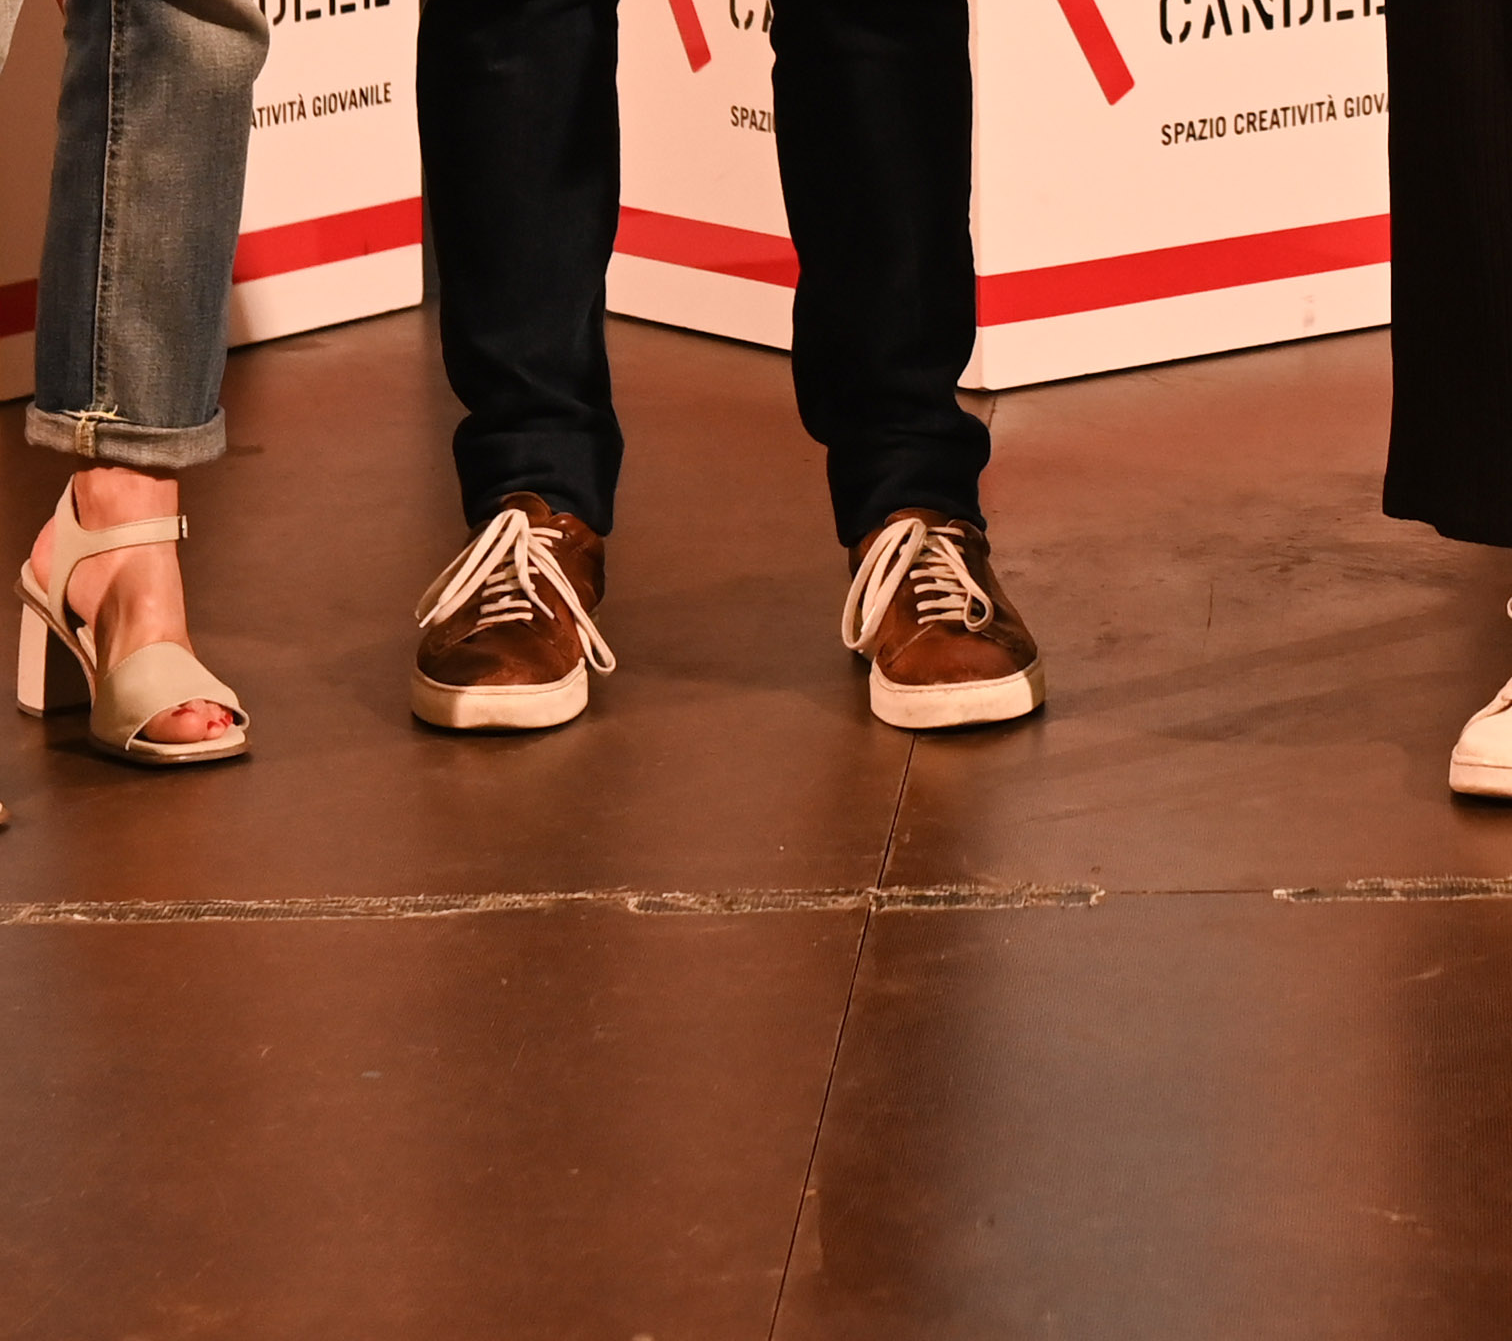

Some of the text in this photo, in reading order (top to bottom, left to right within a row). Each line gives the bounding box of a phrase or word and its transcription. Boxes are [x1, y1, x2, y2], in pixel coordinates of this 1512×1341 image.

[251, 81, 392, 130] ATIVITÀ GIOVANILE
[1161, 116, 1227, 147] SPAZIO
[1234, 93, 1337, 137] CREATIVITÀ
